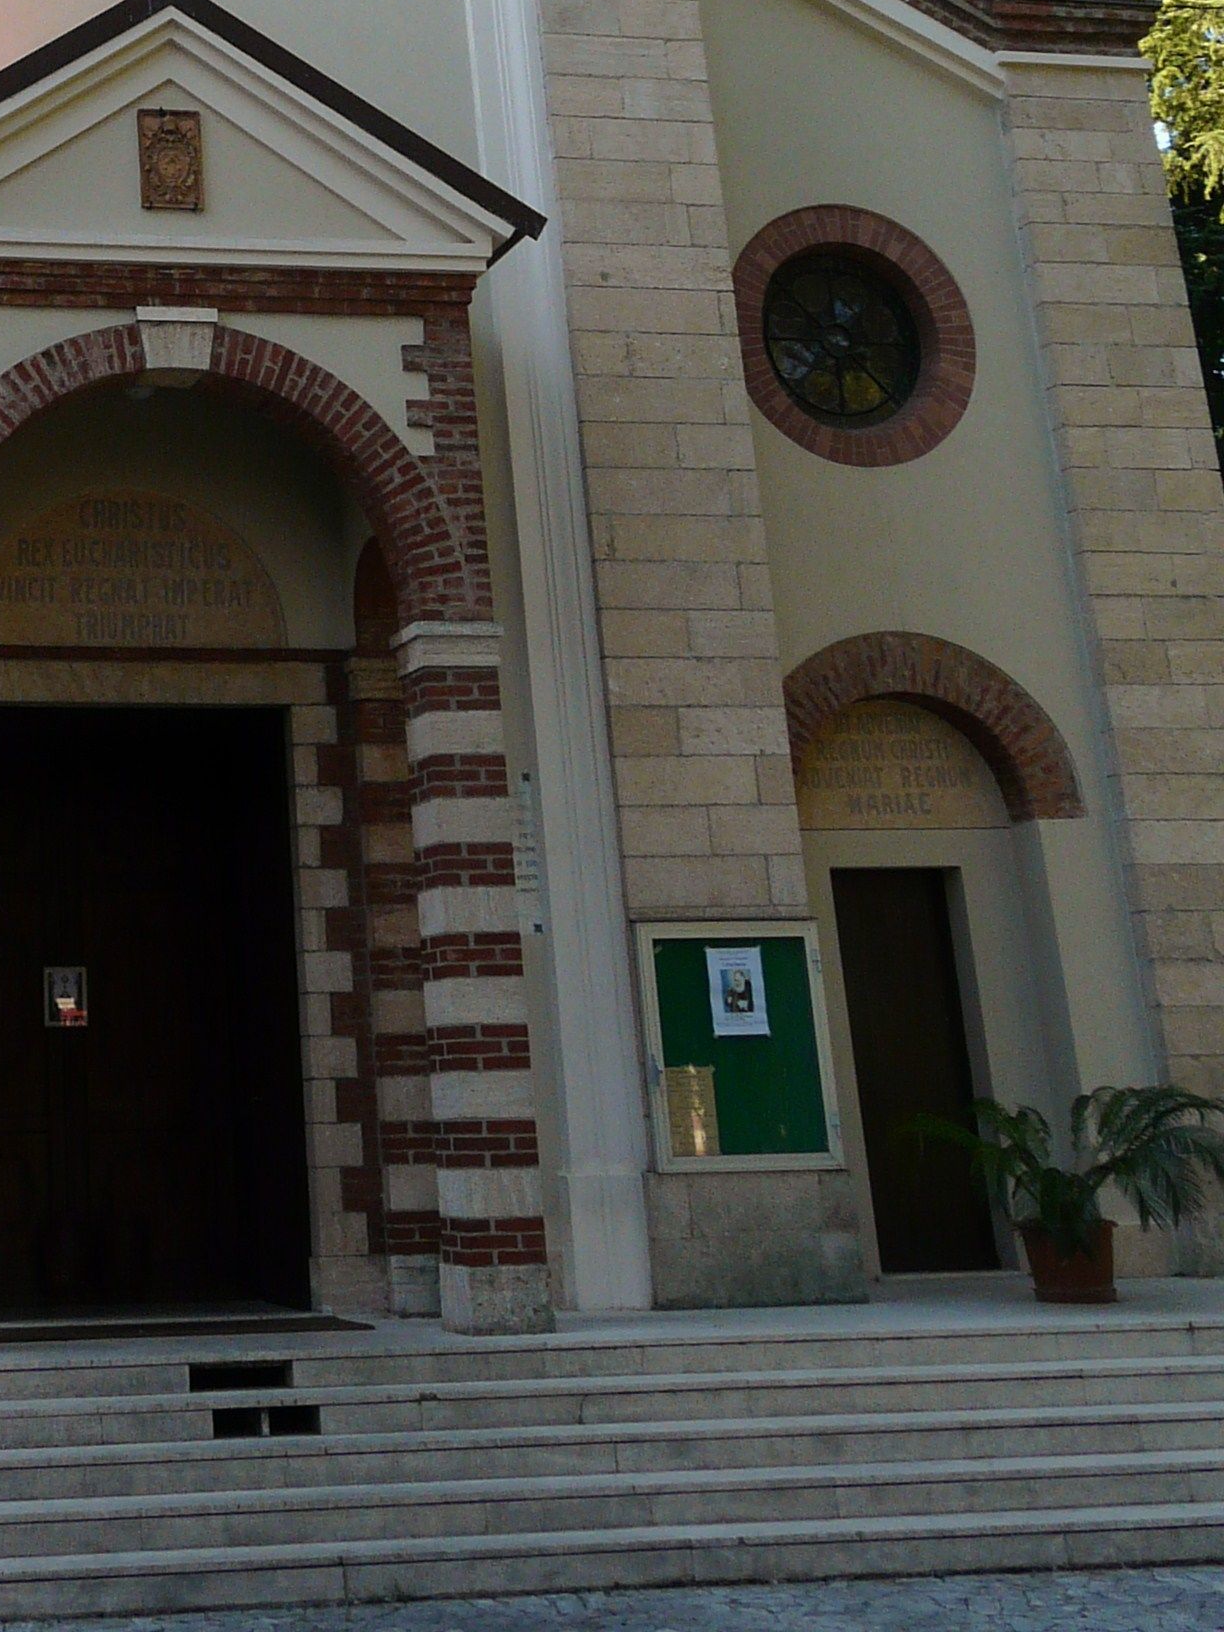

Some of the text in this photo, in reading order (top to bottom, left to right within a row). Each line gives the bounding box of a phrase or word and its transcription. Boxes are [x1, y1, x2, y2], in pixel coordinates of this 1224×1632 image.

[79, 498, 187, 532] CHRISTUS
[17, 537, 233, 571] REX EUCHARISTICUS
[70, 577, 150, 605] REGNAT
[162, 579, 253, 607] IMPERAT
